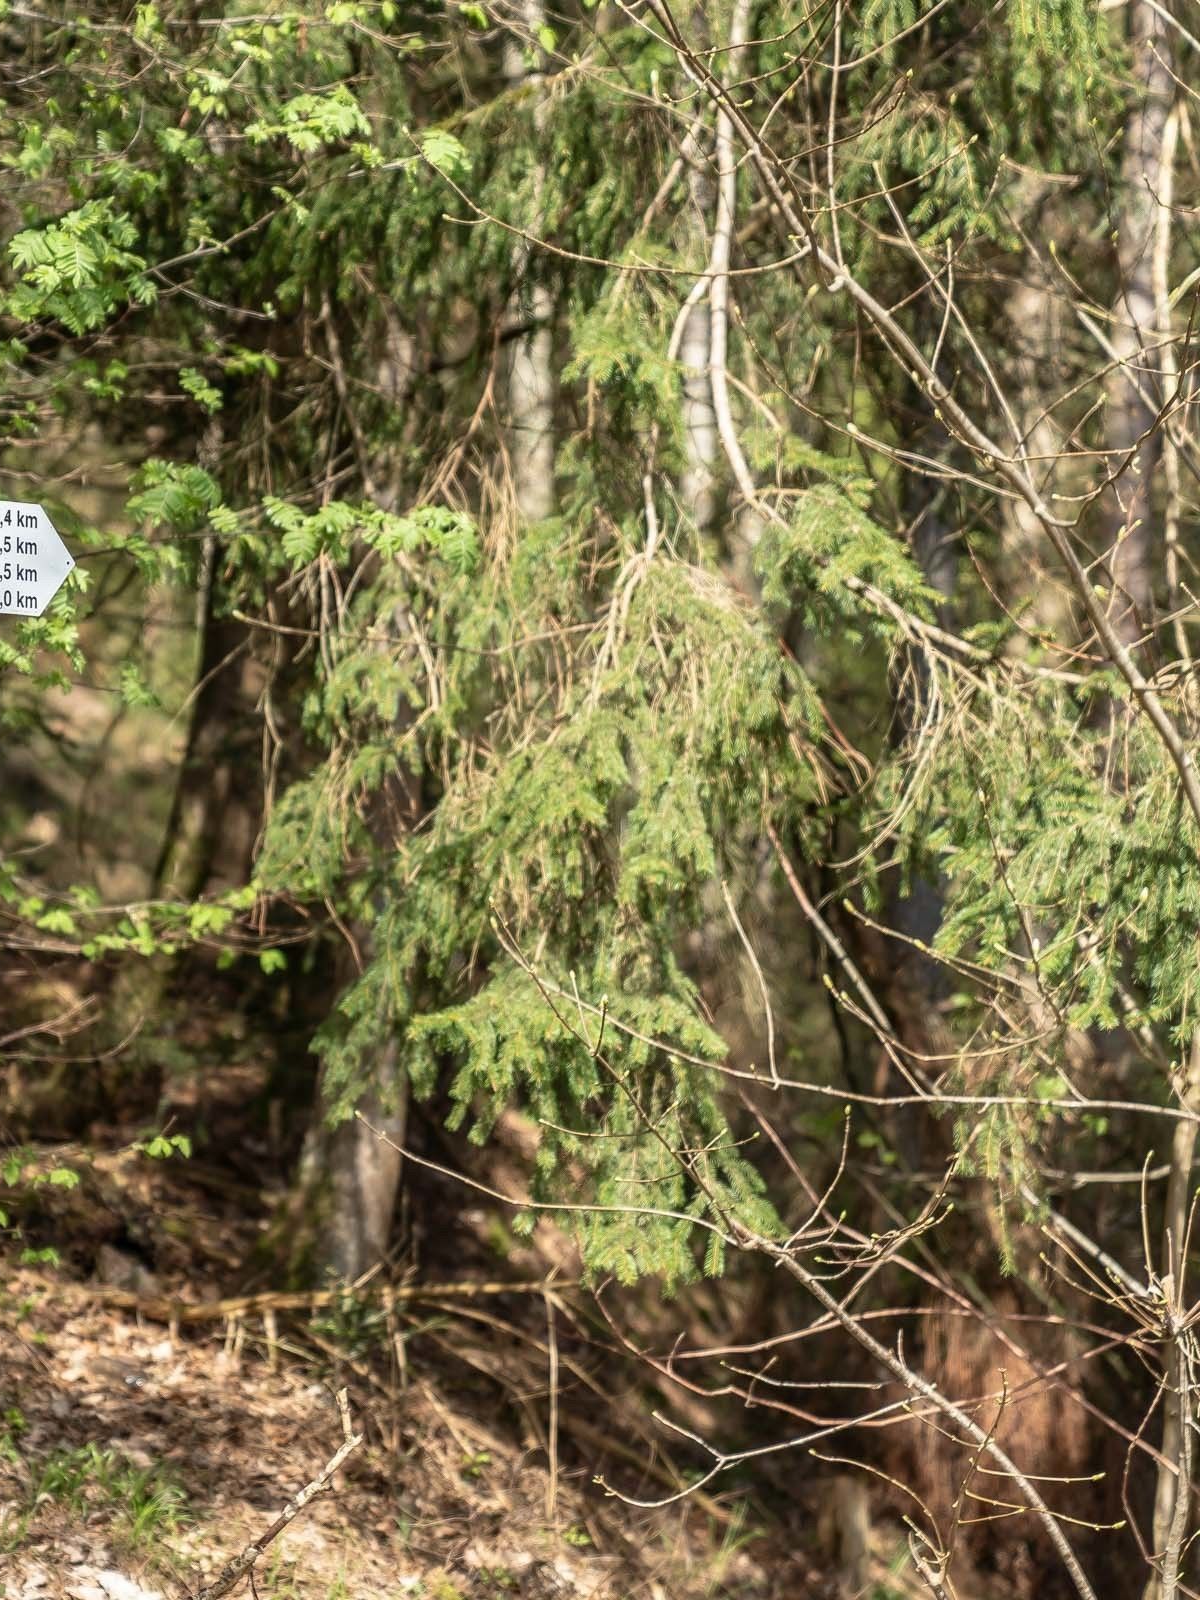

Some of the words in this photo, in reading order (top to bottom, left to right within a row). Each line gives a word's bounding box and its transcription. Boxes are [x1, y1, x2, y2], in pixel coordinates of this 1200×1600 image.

[16, 510, 38, 528] km
[16, 537, 38, 556] km
[16, 564, 38, 582] km
[16, 590, 38, 609] km
